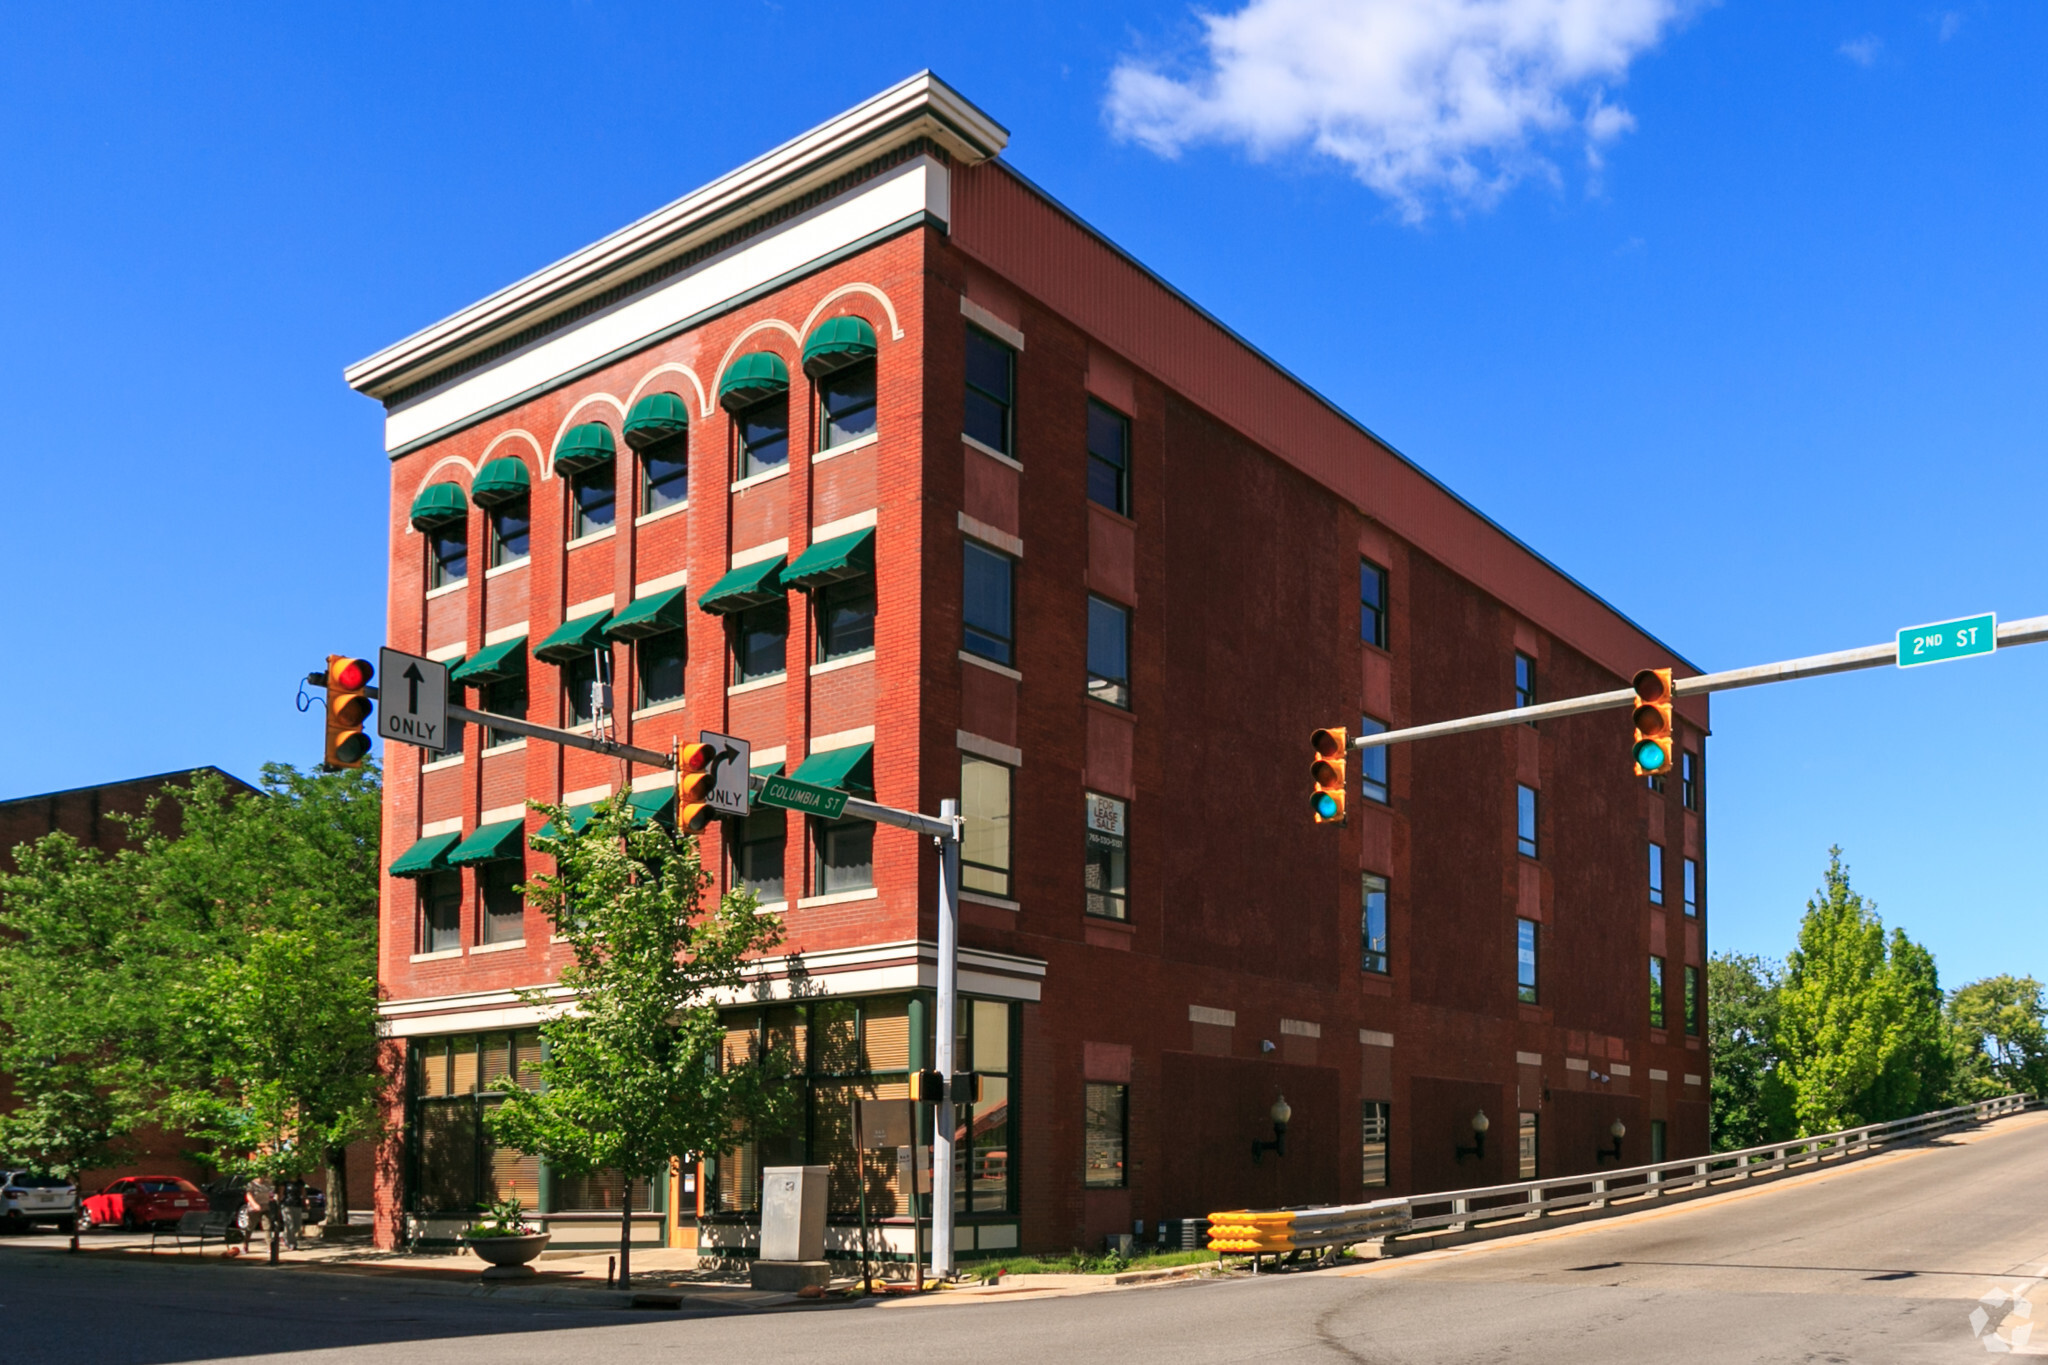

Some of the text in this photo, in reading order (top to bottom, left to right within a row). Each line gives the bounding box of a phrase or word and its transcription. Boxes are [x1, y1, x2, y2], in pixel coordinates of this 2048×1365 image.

[1913, 627, 1979, 655] 2ND ST
[389, 715, 436, 740] ONLY
[706, 788, 742, 807] ONLY
[770, 784, 841, 811] COLUMBIA ST
[1098, 798, 1113, 809] FOR
[1094, 806, 1118, 823] LEASE
[1096, 817, 1116, 831] SALE
